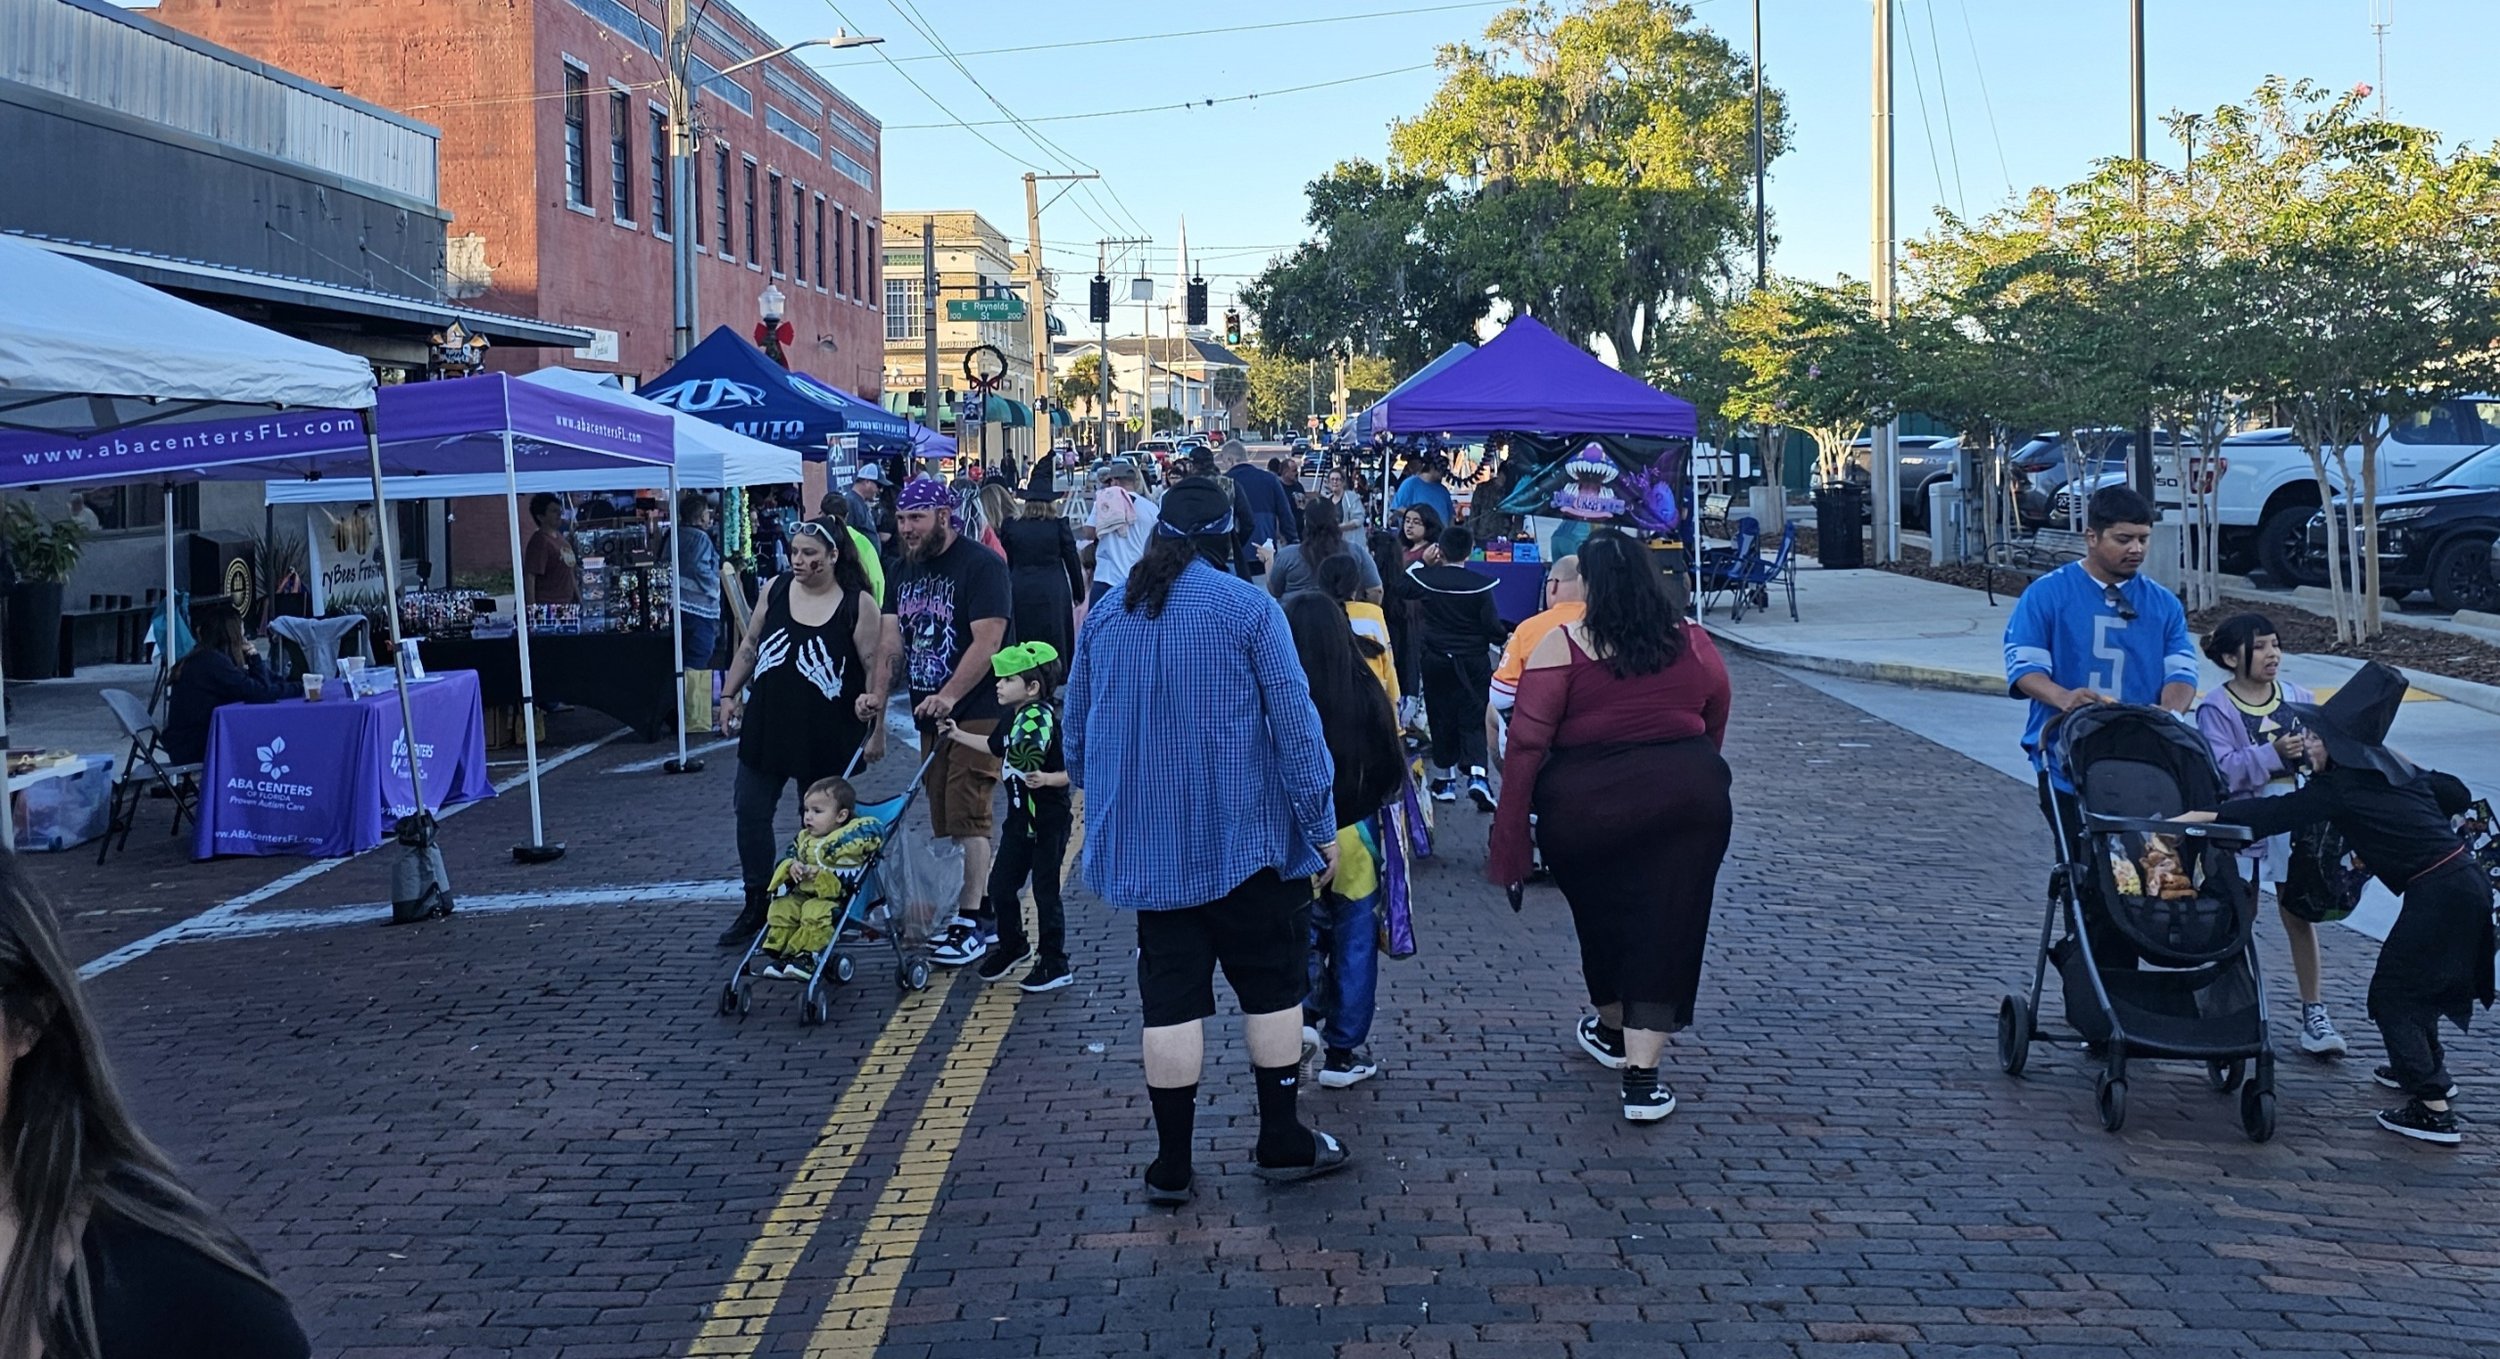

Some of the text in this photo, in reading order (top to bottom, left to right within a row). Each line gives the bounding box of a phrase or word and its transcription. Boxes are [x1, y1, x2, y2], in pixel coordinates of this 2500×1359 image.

[949, 311, 1021, 320] 100 St 200
[961, 302, 1009, 312] E Reynolds
[555, 414, 643, 444] www.abacentersFL.com
[732, 420, 805, 440] AUTO
[23, 418, 355, 465] www.abacentersFL.com
[2088, 614, 2128, 701] 5
[227, 777, 313, 797] ABA CENTERS
[259, 792, 291, 801] FLORIDA
[229, 795, 305, 811] Proven Autism Care
